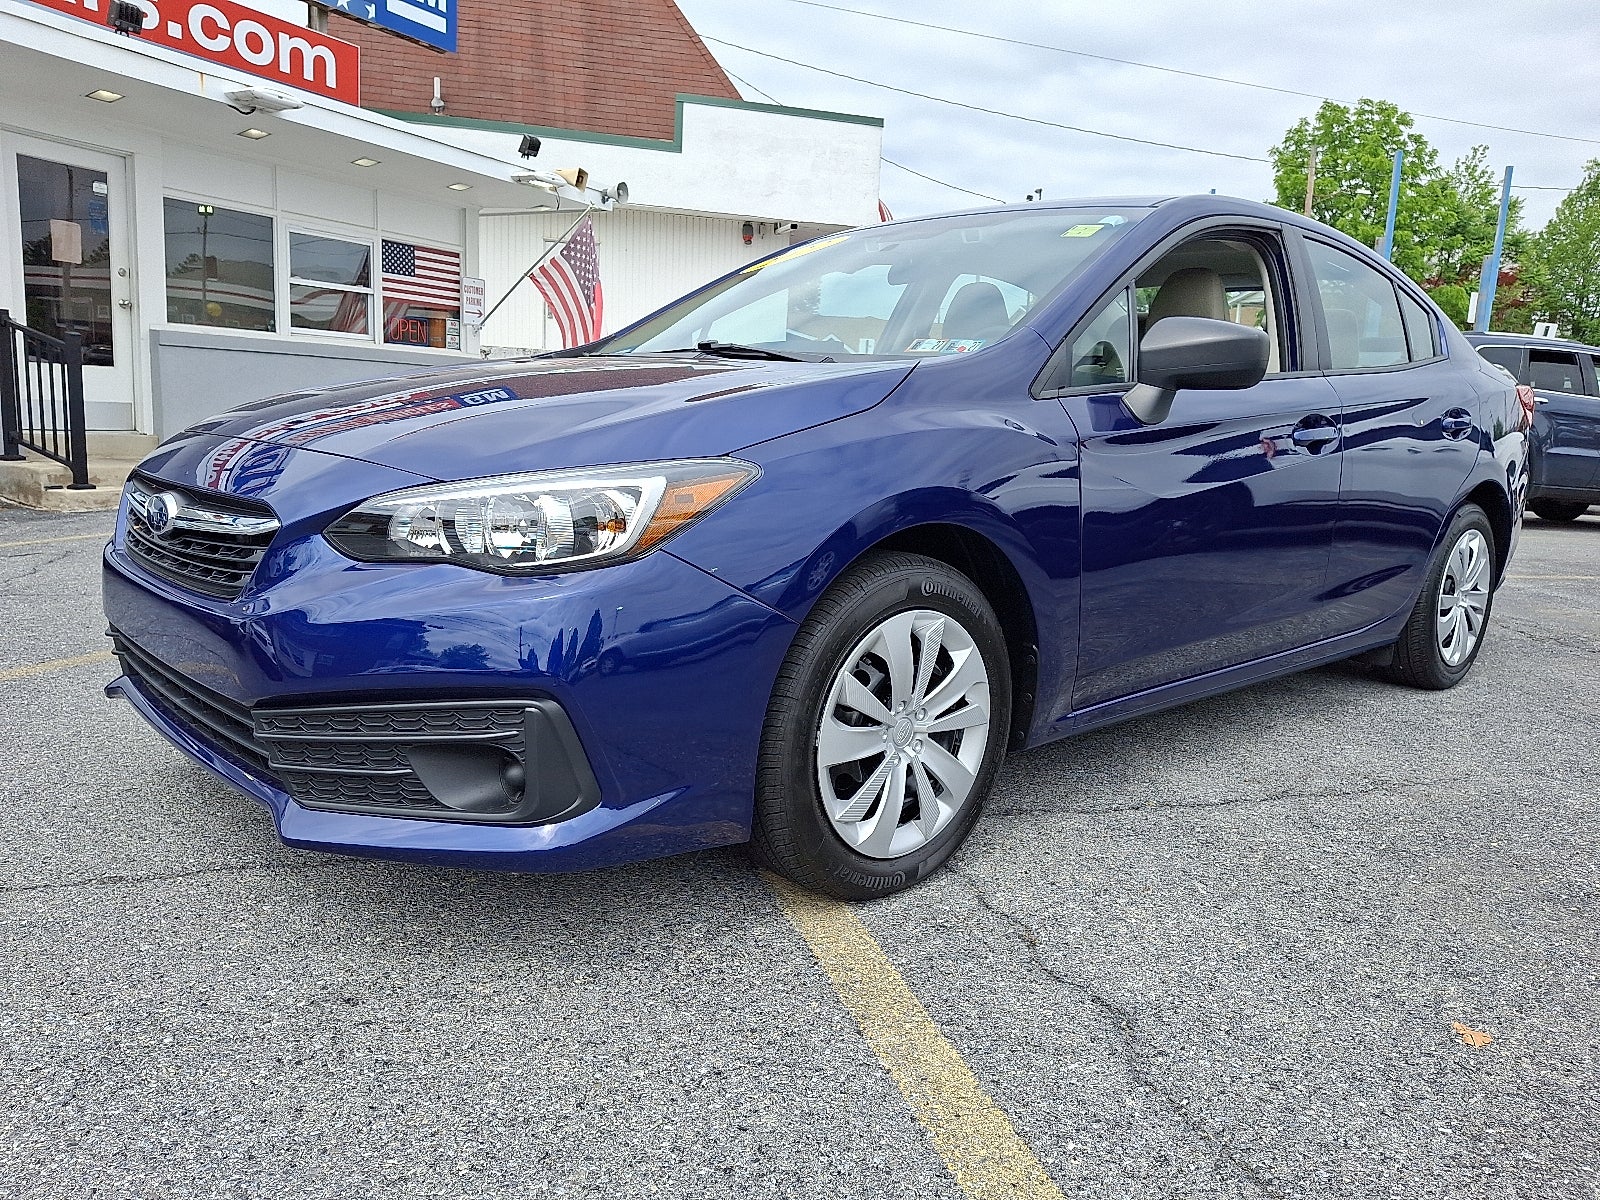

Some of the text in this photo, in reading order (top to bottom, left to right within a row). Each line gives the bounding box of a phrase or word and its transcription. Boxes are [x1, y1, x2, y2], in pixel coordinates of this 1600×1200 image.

[62, 0, 337, 89] .com
[463, 284, 484, 296] CUSTOMER
[465, 296, 482, 307] PARKING
[391, 317, 427, 343] OPEN
[921, 579, 982, 619] Continental
[833, 865, 906, 890] Continental
